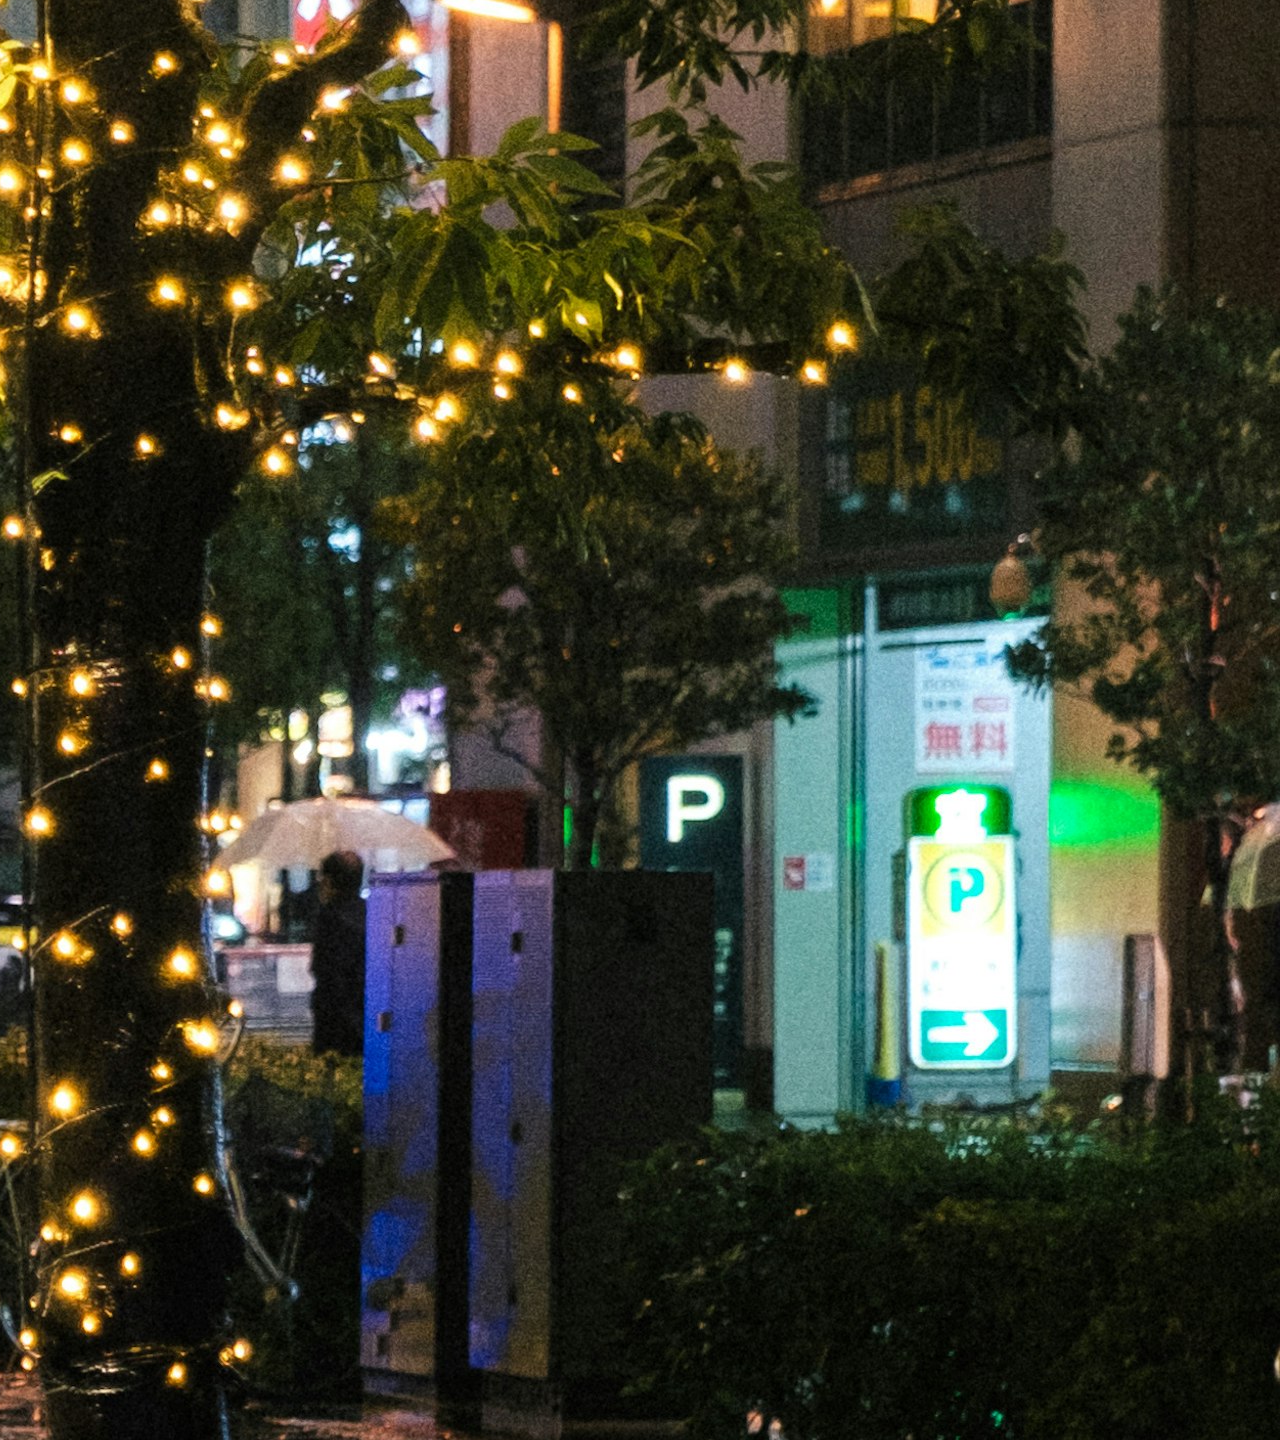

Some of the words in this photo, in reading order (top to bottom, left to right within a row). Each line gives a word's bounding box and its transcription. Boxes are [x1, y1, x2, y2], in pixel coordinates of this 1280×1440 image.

[924, 721, 1008, 759] 無料
[666, 773, 725, 843] P
[949, 867, 985, 913] P
